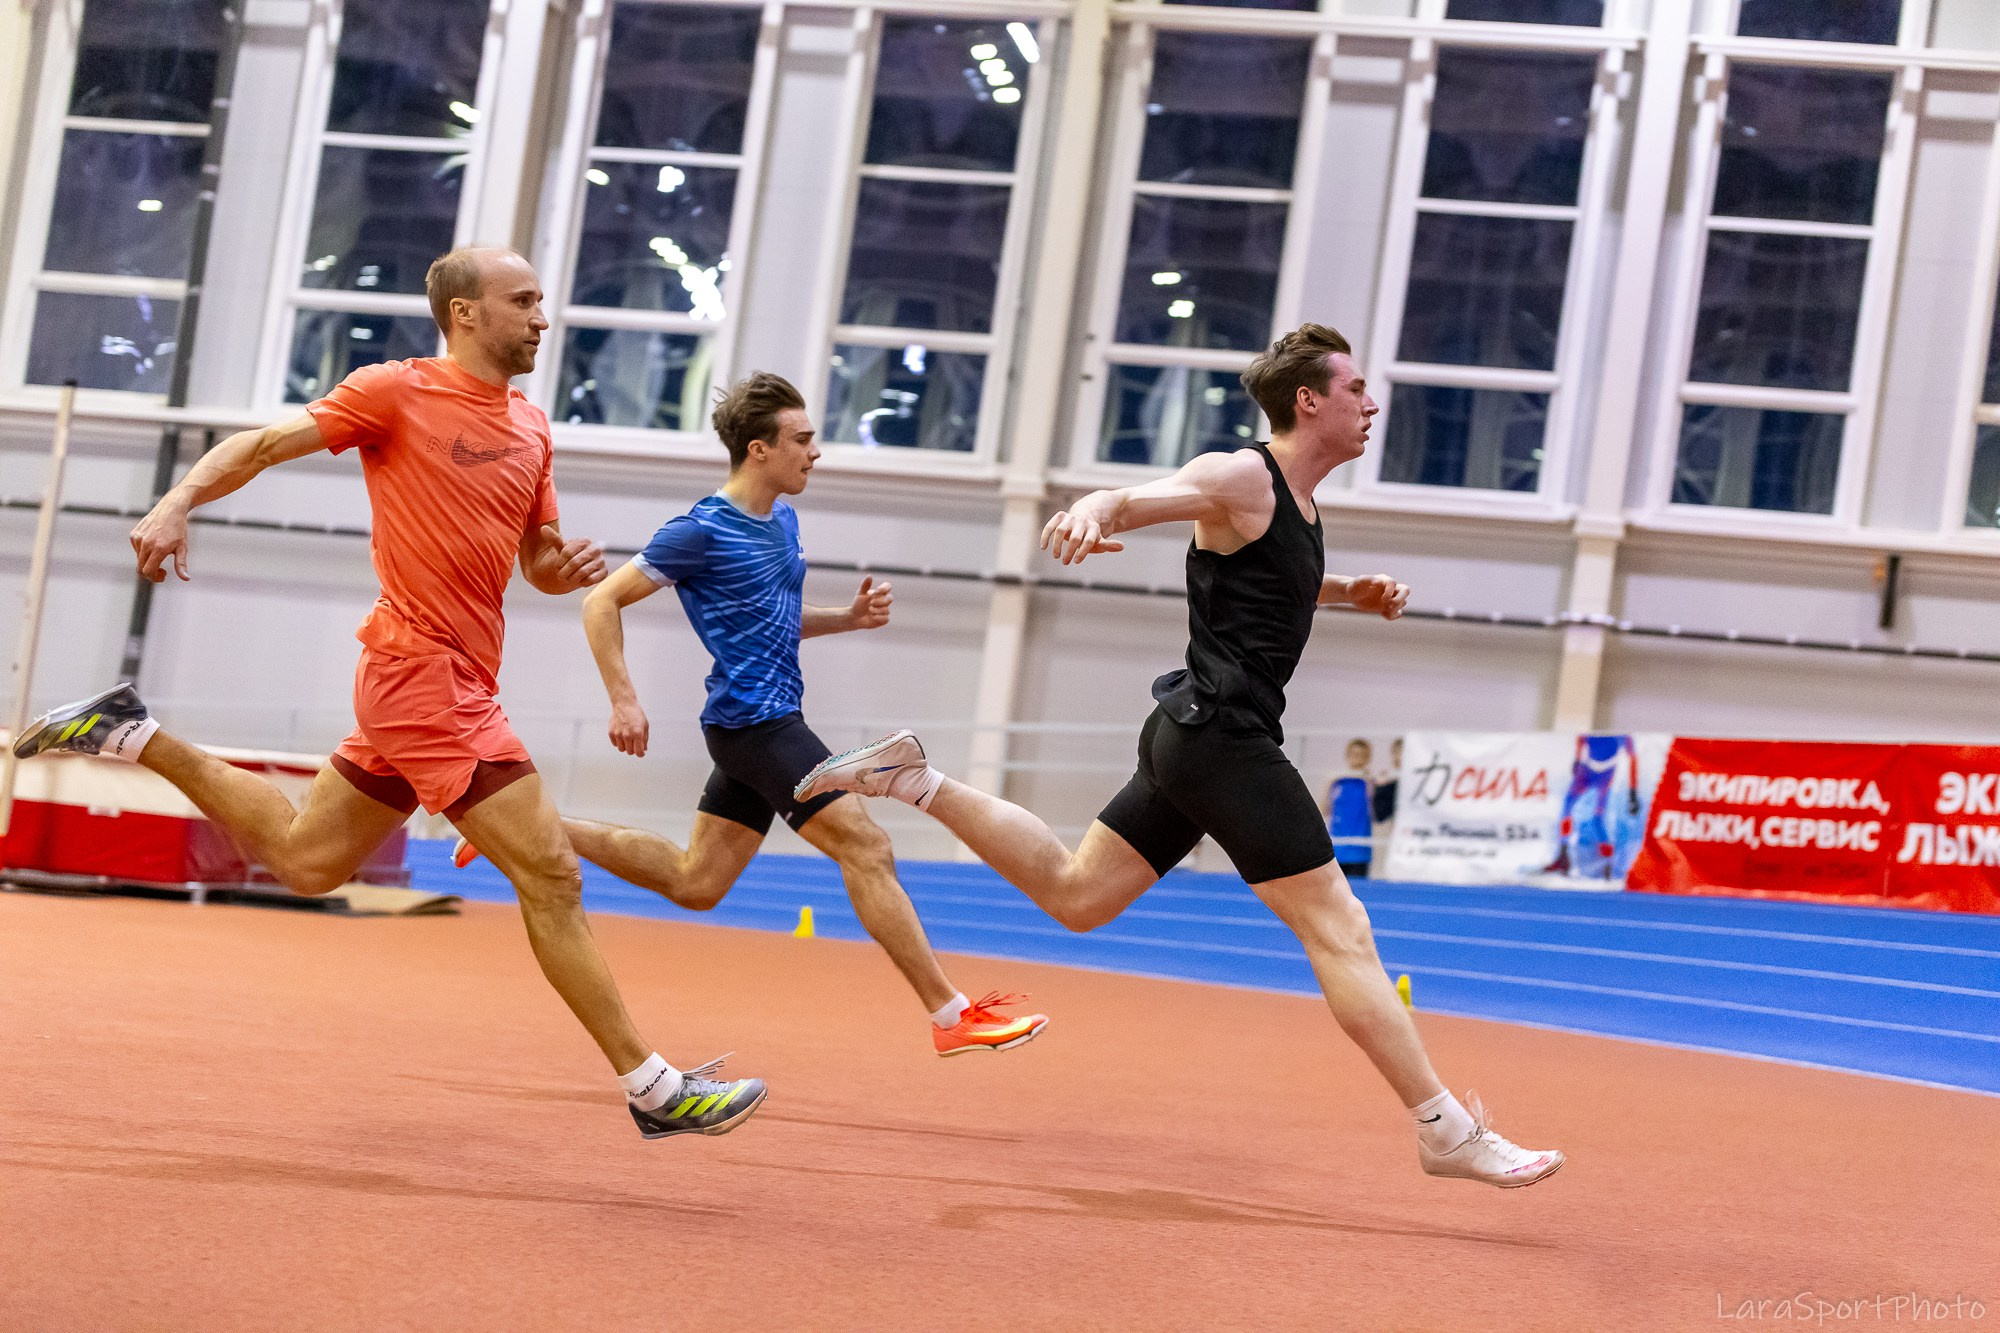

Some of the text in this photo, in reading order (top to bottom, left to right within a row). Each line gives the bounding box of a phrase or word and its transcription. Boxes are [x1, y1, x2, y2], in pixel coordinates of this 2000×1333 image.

[426, 435, 500, 460] NKE
[1453, 767, 1548, 799] СИЛА
[1678, 771, 1891, 816] ЭКИПИРОВКА,
[1934, 771, 2000, 815] ЭК
